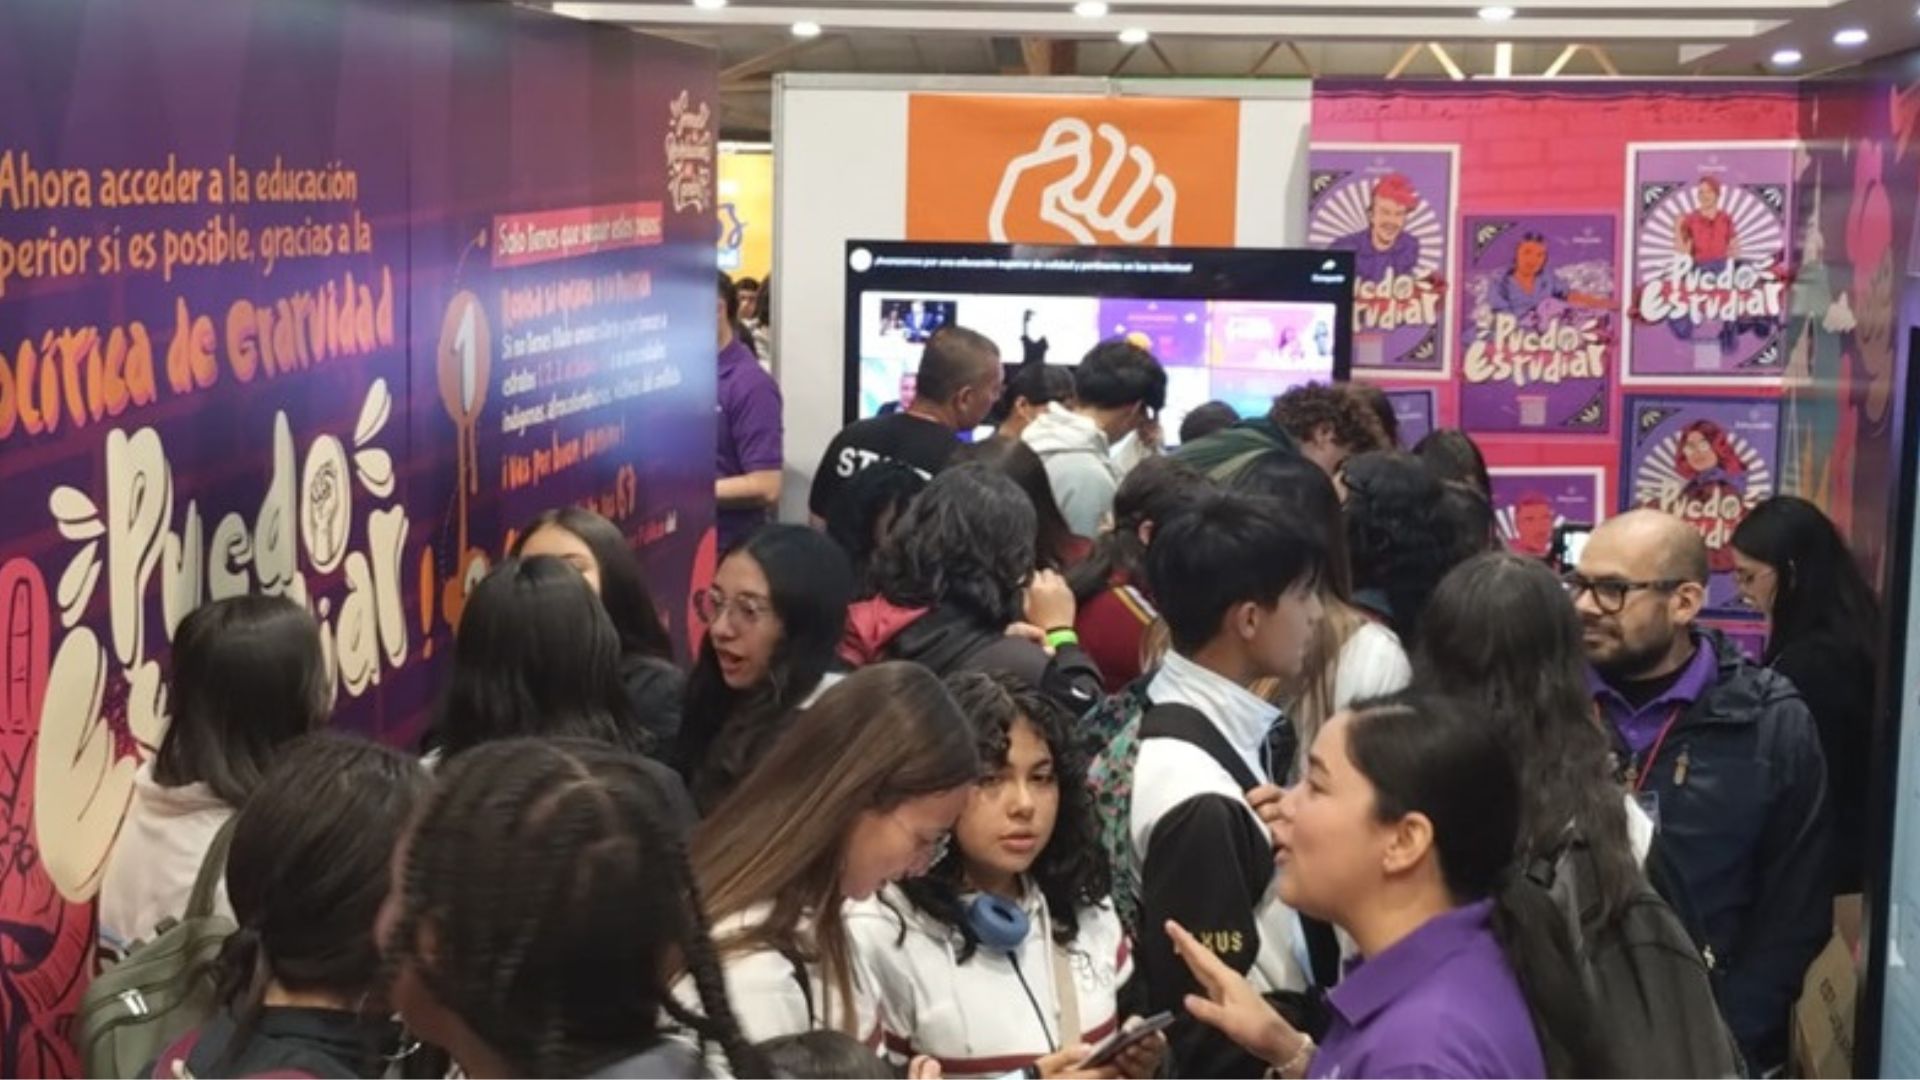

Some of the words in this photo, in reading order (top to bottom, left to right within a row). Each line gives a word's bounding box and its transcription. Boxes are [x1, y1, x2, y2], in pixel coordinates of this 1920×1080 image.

[0, 150, 92, 211] Ahora
[100, 153, 203, 208] acceder
[208, 168, 223, 204] a
[229, 153, 249, 203] la
[255, 155, 357, 204] educación
[129, 231, 156, 270] es
[164, 214, 255, 282] posible,
[260, 215, 333, 277] gracias
[338, 222, 349, 254] a
[354, 209, 372, 254] la
[1670, 252, 1756, 290] Puedo
[1640, 279, 1784, 324] Estudiar
[167, 296, 218, 394] de
[454, 300, 477, 412] 1
[1463, 340, 1605, 386] Estudiar
[1495, 313, 1580, 352] Puedo
[106, 410, 352, 668] Puedo
